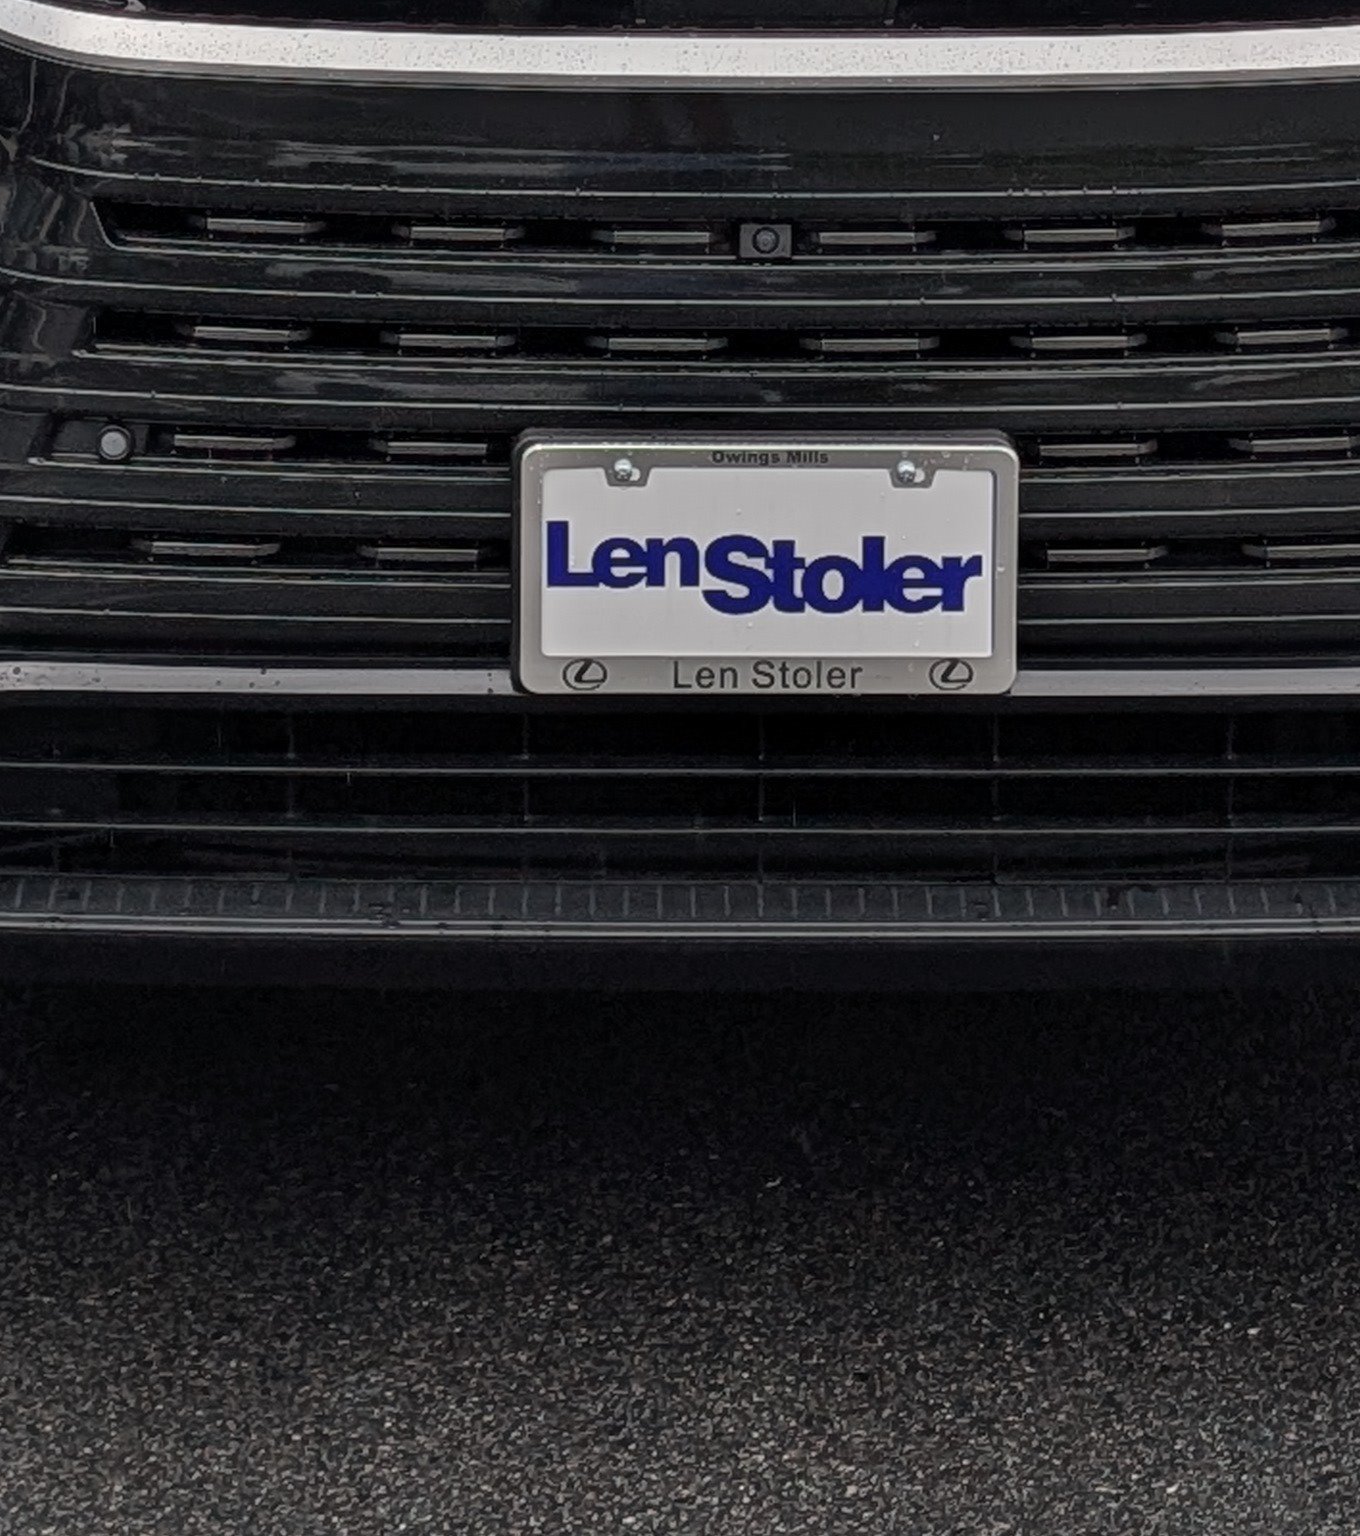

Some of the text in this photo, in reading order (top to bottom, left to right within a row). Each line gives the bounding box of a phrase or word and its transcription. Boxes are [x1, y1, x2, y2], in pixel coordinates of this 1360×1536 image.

[712, 450, 829, 465] Owings Mills
[673, 661, 863, 690] Len Stoler
